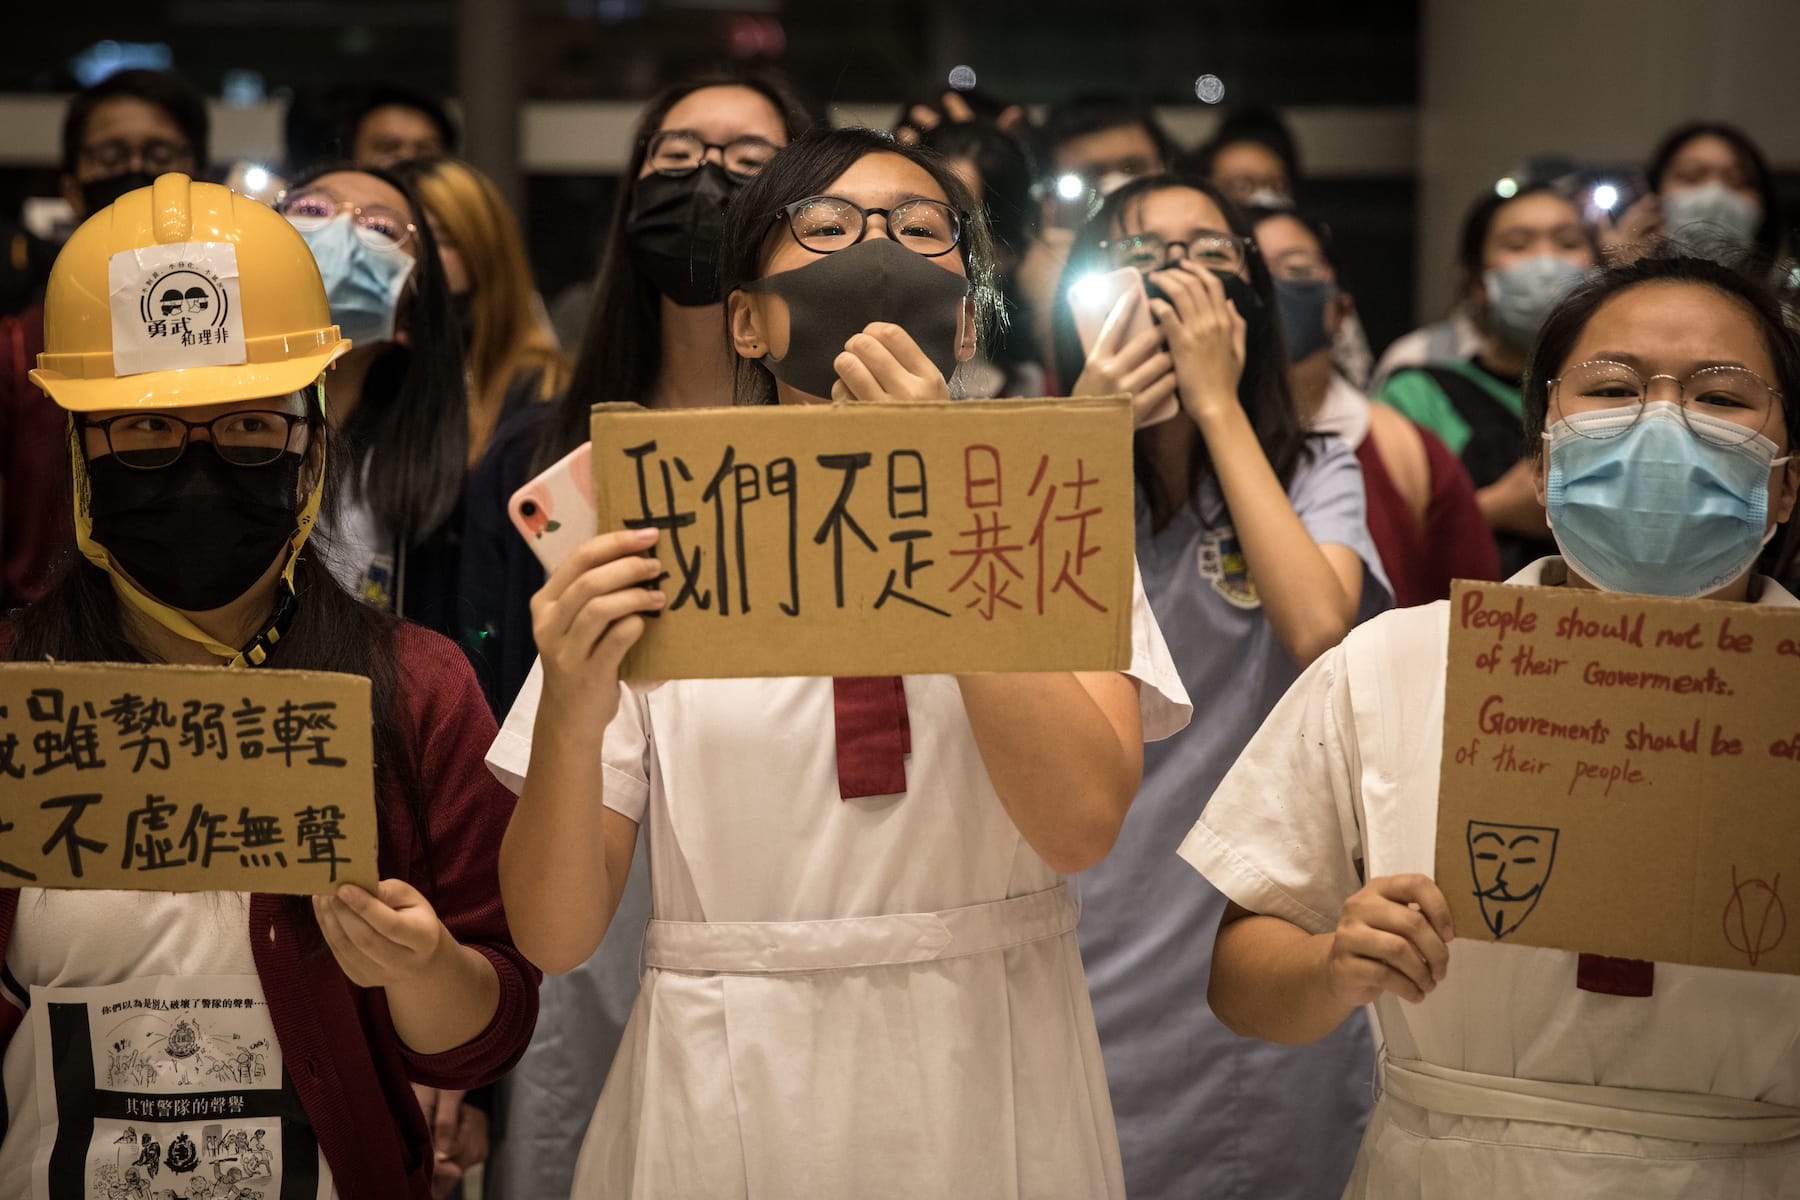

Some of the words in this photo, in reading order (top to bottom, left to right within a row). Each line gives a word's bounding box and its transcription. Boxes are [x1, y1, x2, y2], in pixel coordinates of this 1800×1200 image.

[148, 317, 192, 338] 勇武
[181, 327, 229, 347] 和理非
[622, 439, 1108, 620] 我們不是暴徒
[1461, 589, 1538, 641] People
[1555, 607, 1646, 648] should
[1655, 623, 1704, 650] not
[1717, 617, 1754, 653] be
[1776, 638, 1800, 658] a
[1475, 644, 1502, 674] of
[1511, 645, 1568, 677] their
[1625, 718, 1700, 754] should
[1710, 724, 1743, 756] be
[1455, 738, 1480, 766] of
[1492, 743, 1550, 774] their
[1567, 758, 1653, 797] people.
[126, 1095, 244, 1118] 其實警隊的聲譽
